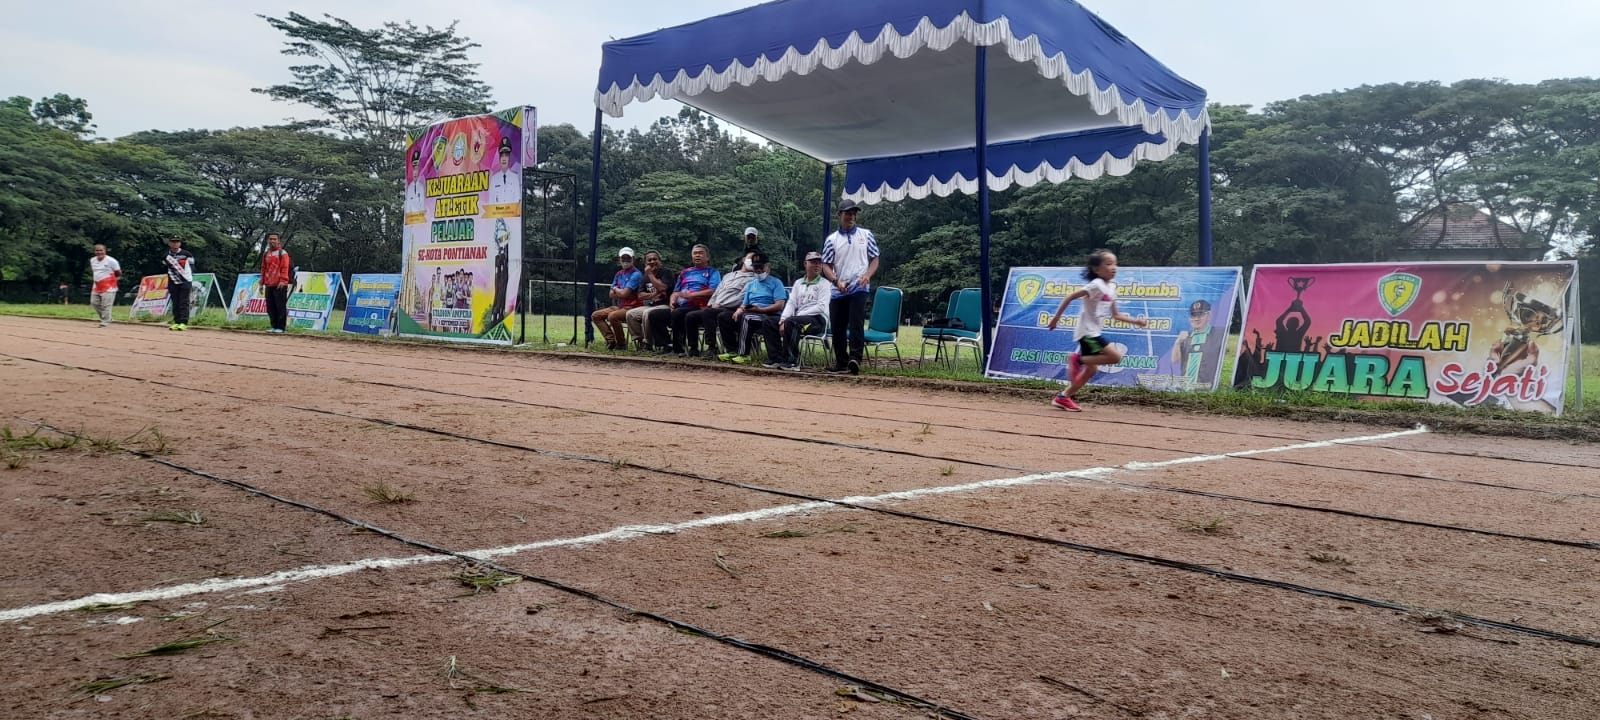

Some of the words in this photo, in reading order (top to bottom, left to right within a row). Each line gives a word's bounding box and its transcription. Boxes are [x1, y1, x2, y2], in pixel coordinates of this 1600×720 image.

[426, 170, 489, 198] KEJUARAAN
[434, 194, 479, 218] ATLETIK
[431, 218, 475, 243] PELAJAR
[443, 246, 487, 260] PONTIANAK
[1045, 280, 1084, 297] Sela
[1114, 281, 1179, 297] erlomba
[1135, 314, 1171, 330] ara
[1330, 320, 1470, 351] JADILAH
[1012, 349, 1041, 362] PASI
[1042, 351, 1070, 365] KOT
[1251, 352, 1430, 399] JUARA
[1436, 363, 1551, 405] Sejati
